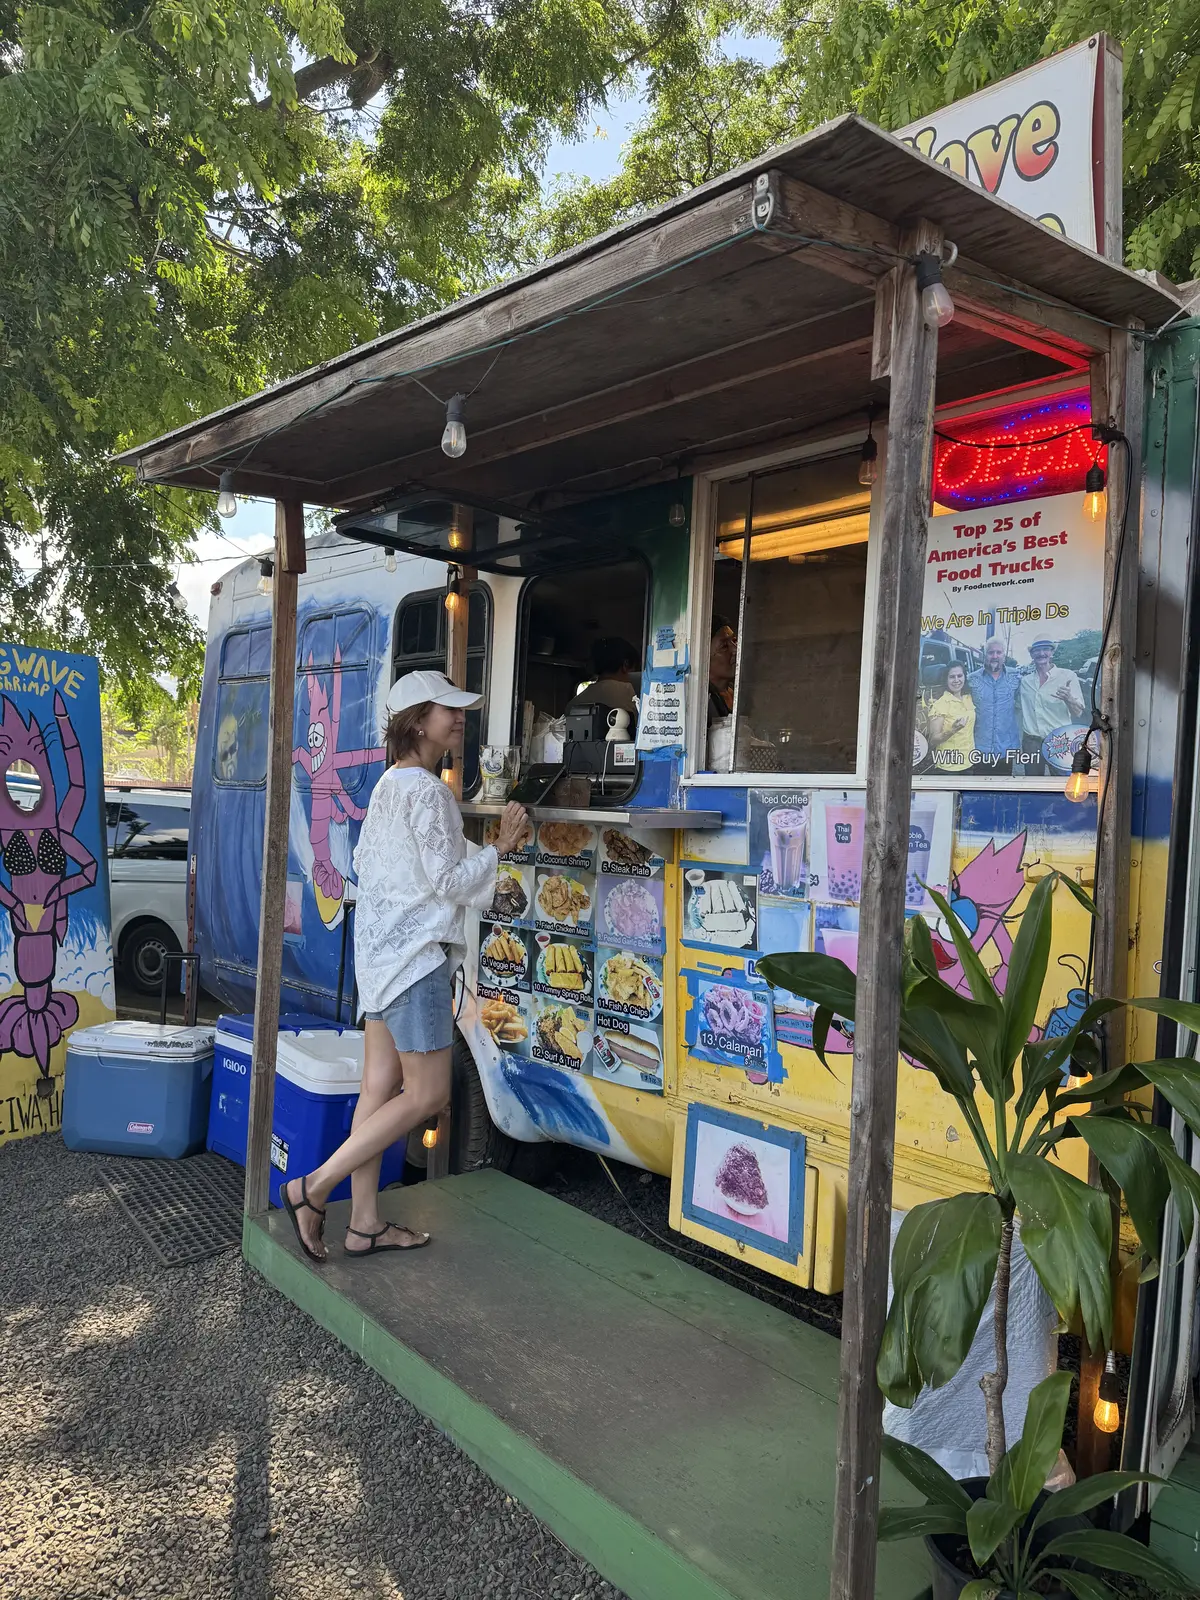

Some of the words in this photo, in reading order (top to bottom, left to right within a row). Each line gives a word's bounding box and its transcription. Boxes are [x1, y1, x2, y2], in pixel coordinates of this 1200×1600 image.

[953, 524, 987, 539] Top
[992, 517, 1014, 533] 25
[1020, 511, 1042, 529] of
[927, 539, 1016, 563] America's
[1023, 530, 1068, 550] Best
[937, 564, 982, 583] Food
[988, 556, 1055, 576] Trucks
[963, 577, 1035, 591] Foodnetwork.com
[920, 615, 944, 631] We
[946, 612, 974, 629] Are
[978, 609, 992, 625] In
[996, 604, 1042, 625] Triple
[1045, 602, 1070, 619] Ds
[12, 648, 86, 699] WAVE
[931, 748, 964, 764] With
[969, 749, 1001, 768] Guy
[1005, 749, 1041, 764] Fieri
[762, 795, 779, 804] Iced
[780, 794, 808, 804] Coffee
[837, 825, 850, 833] Thai
[837, 833, 849, 841] Tea
[915, 840, 928, 848] Tea
[509, 852, 528, 863] Pepper
[544, 855, 567, 864] Coconut
[568, 858, 590, 867] Shrimp
[611, 863, 630, 873] Steak
[632, 866, 650, 876] Plate
[498, 913, 511, 922] Plate
[555, 924, 575, 933] Chicken
[481, 957, 488, 966] 9.
[489, 958, 509, 970] Veggie
[509, 962, 525, 974] Plate
[477, 985, 500, 998] French
[502, 990, 519, 1003] Fries
[562, 990, 579, 1002] Spring
[580, 994, 594, 1003] Rolls
[609, 1000, 622, 1011] Fish
[623, 1005, 629, 1013] &
[630, 1006, 648, 1018] Chips
[597, 1015, 610, 1026] Hot
[612, 1018, 629, 1032] Dog
[702, 1033, 715, 1046] 13.
[718, 1036, 762, 1058] Calamari
[532, 1047, 543, 1058] 12.
[544, 1050, 558, 1061] Surf
[559, 1054, 564, 1063] &
[566, 1056, 581, 1068] Turf
